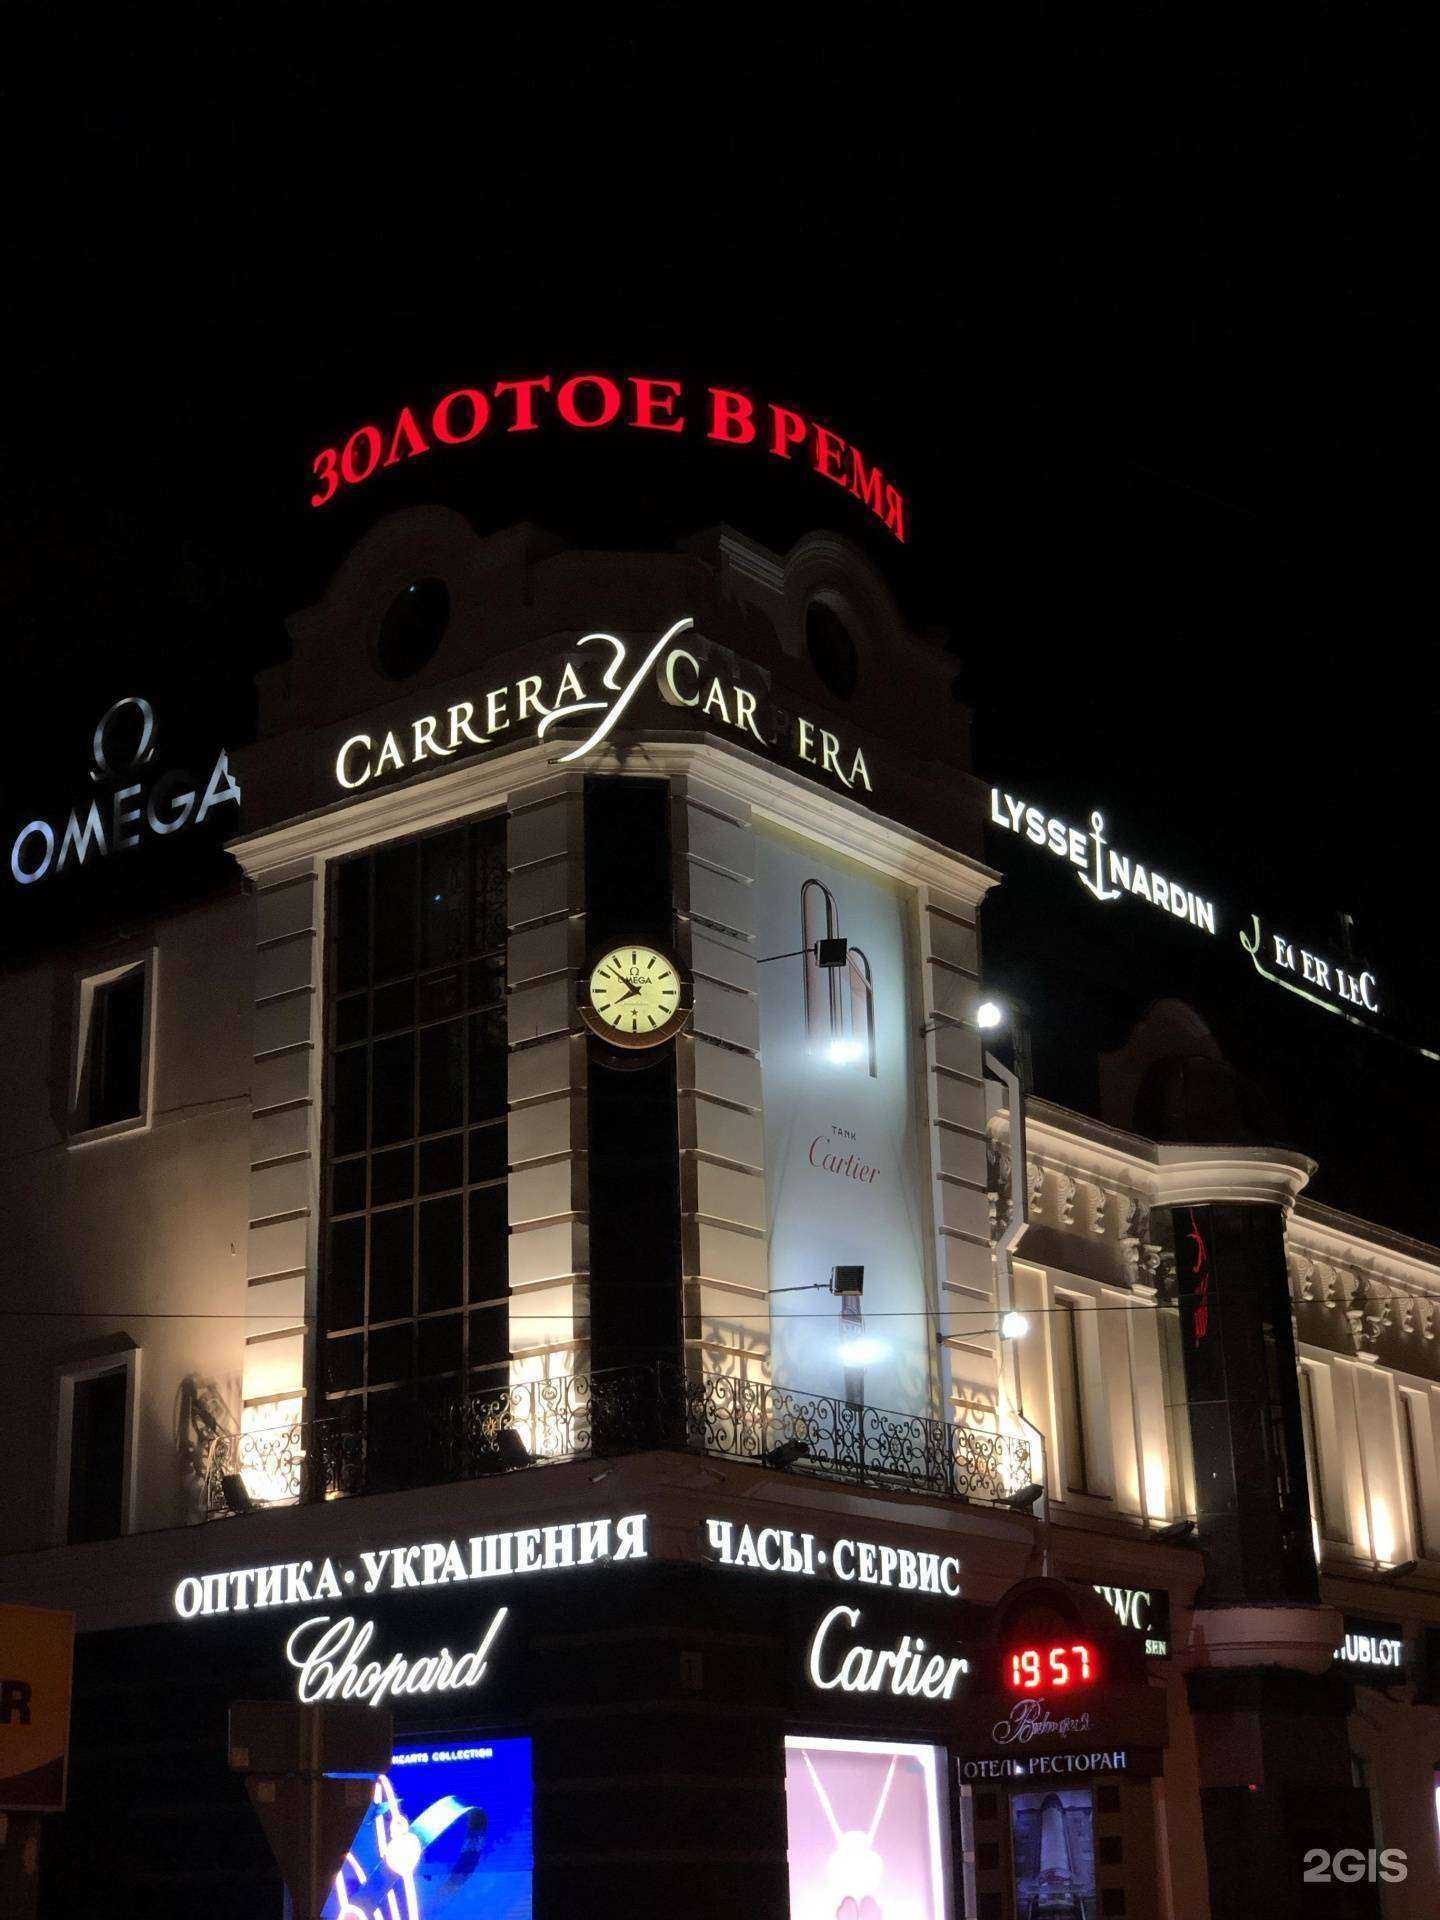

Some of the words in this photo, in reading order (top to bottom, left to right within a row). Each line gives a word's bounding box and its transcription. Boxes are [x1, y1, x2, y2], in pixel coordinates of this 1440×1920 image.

[310, 374, 685, 507] ЗОЛОТОЕ
[706, 386, 909, 544] ВРЕМЯ
[335, 662, 589, 790] CARRERA
[657, 648, 873, 792] CARERA
[11, 747, 242, 884] OMEGA
[990, 787, 1087, 868] LYSSE
[1109, 849, 1216, 936] NARDIN
[809, 1135, 881, 1184] Cartier
[831, 1125, 857, 1141] TANK
[174, 1557, 343, 1619] ОПТИКА
[360, 1513, 649, 1594] УКРАШЕНИЯ
[705, 1518, 816, 1576] ЧАСЫ
[832, 1538, 961, 1596] СЕРВИС
[286, 1606, 509, 1707] Chopard
[809, 1604, 969, 1700] Cartier
[1092, 1585, 1152, 1632] WC
[432, 1748, 494, 1763] COLLECTION
[1029, 1751, 1127, 1775] РЕСТОРАН
